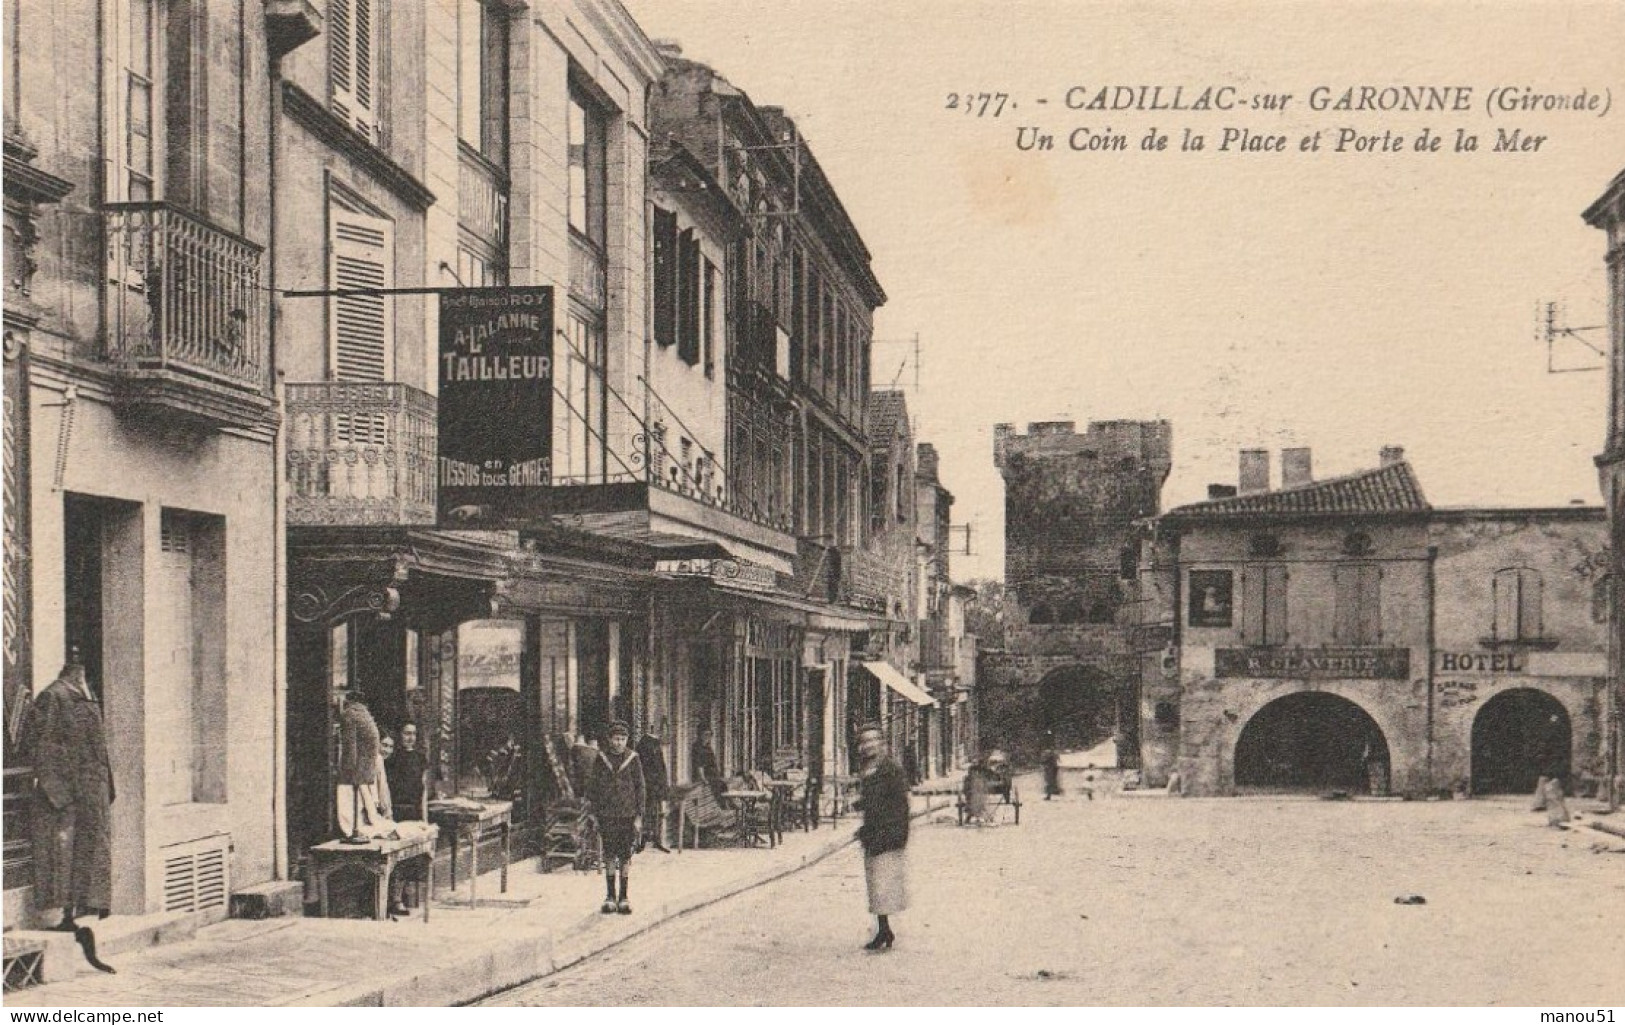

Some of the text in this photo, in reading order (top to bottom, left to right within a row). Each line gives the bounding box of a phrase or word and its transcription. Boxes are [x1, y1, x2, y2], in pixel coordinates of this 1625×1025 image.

[510, 292, 547, 306] ROY
[443, 352, 551, 381] TAILLEUR
[440, 456, 480, 487] TISSUS
[485, 459, 503, 469] en
[482, 473, 507, 487] tous
[1441, 653, 1522, 672] HOTEL
